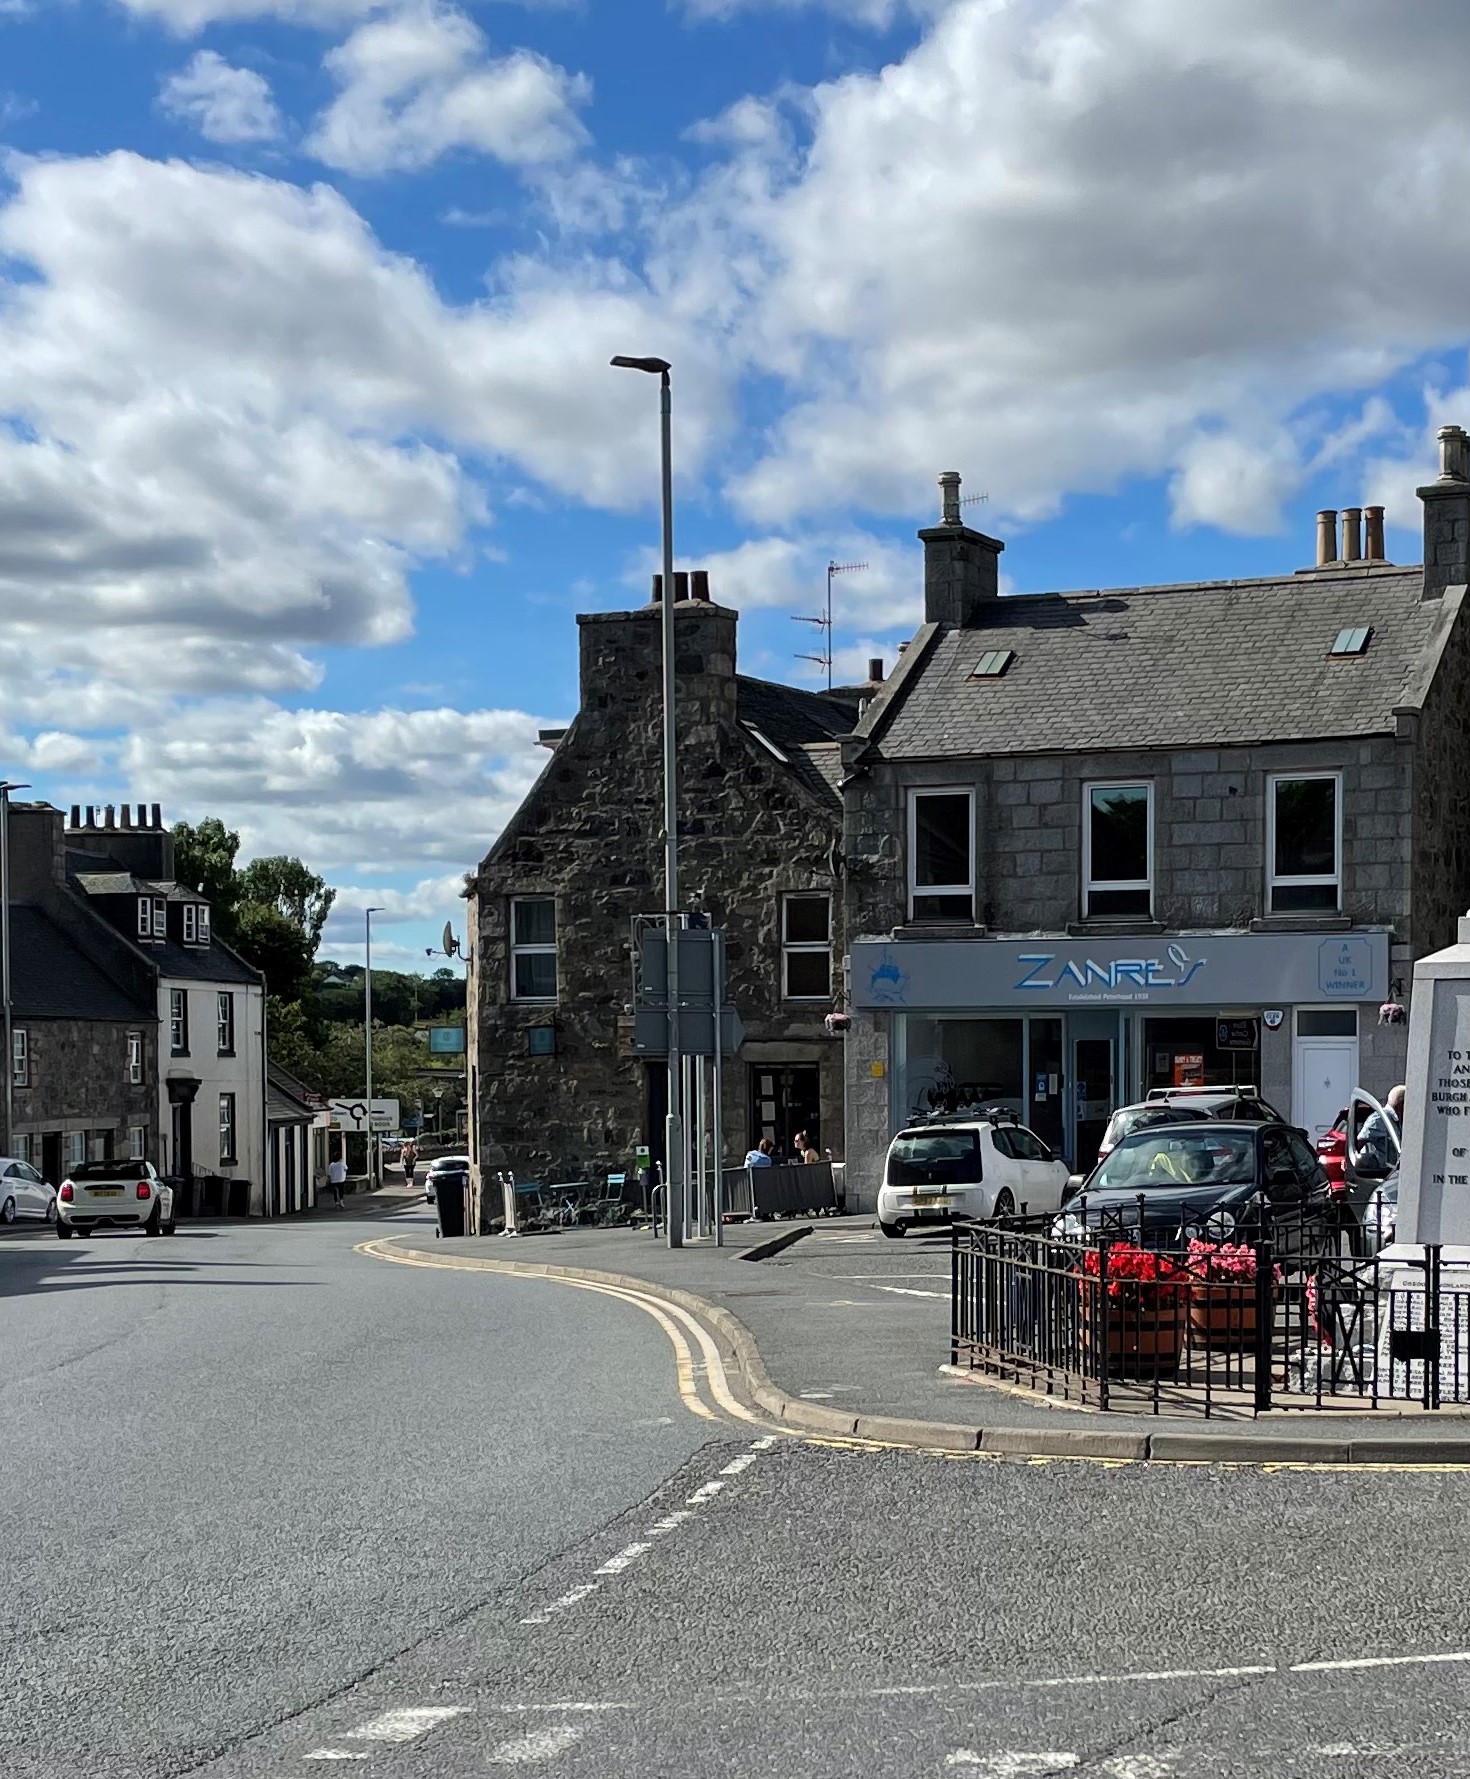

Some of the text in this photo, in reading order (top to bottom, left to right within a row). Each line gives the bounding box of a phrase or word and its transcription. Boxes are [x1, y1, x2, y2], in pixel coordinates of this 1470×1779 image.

[1342, 943, 1349, 952] A
[1338, 956, 1352, 965] UK
[1326, 980, 1365, 989] WINNER
[1447, 1050, 1461, 1060] TO
[1432, 1092, 1467, 1102] BURGH
[1437, 1106, 1460, 1115] WHO
[1452, 1147, 1468, 1157] OF
[1433, 1174, 1445, 1184] IN
[1448, 1174, 1468, 1184] THE
